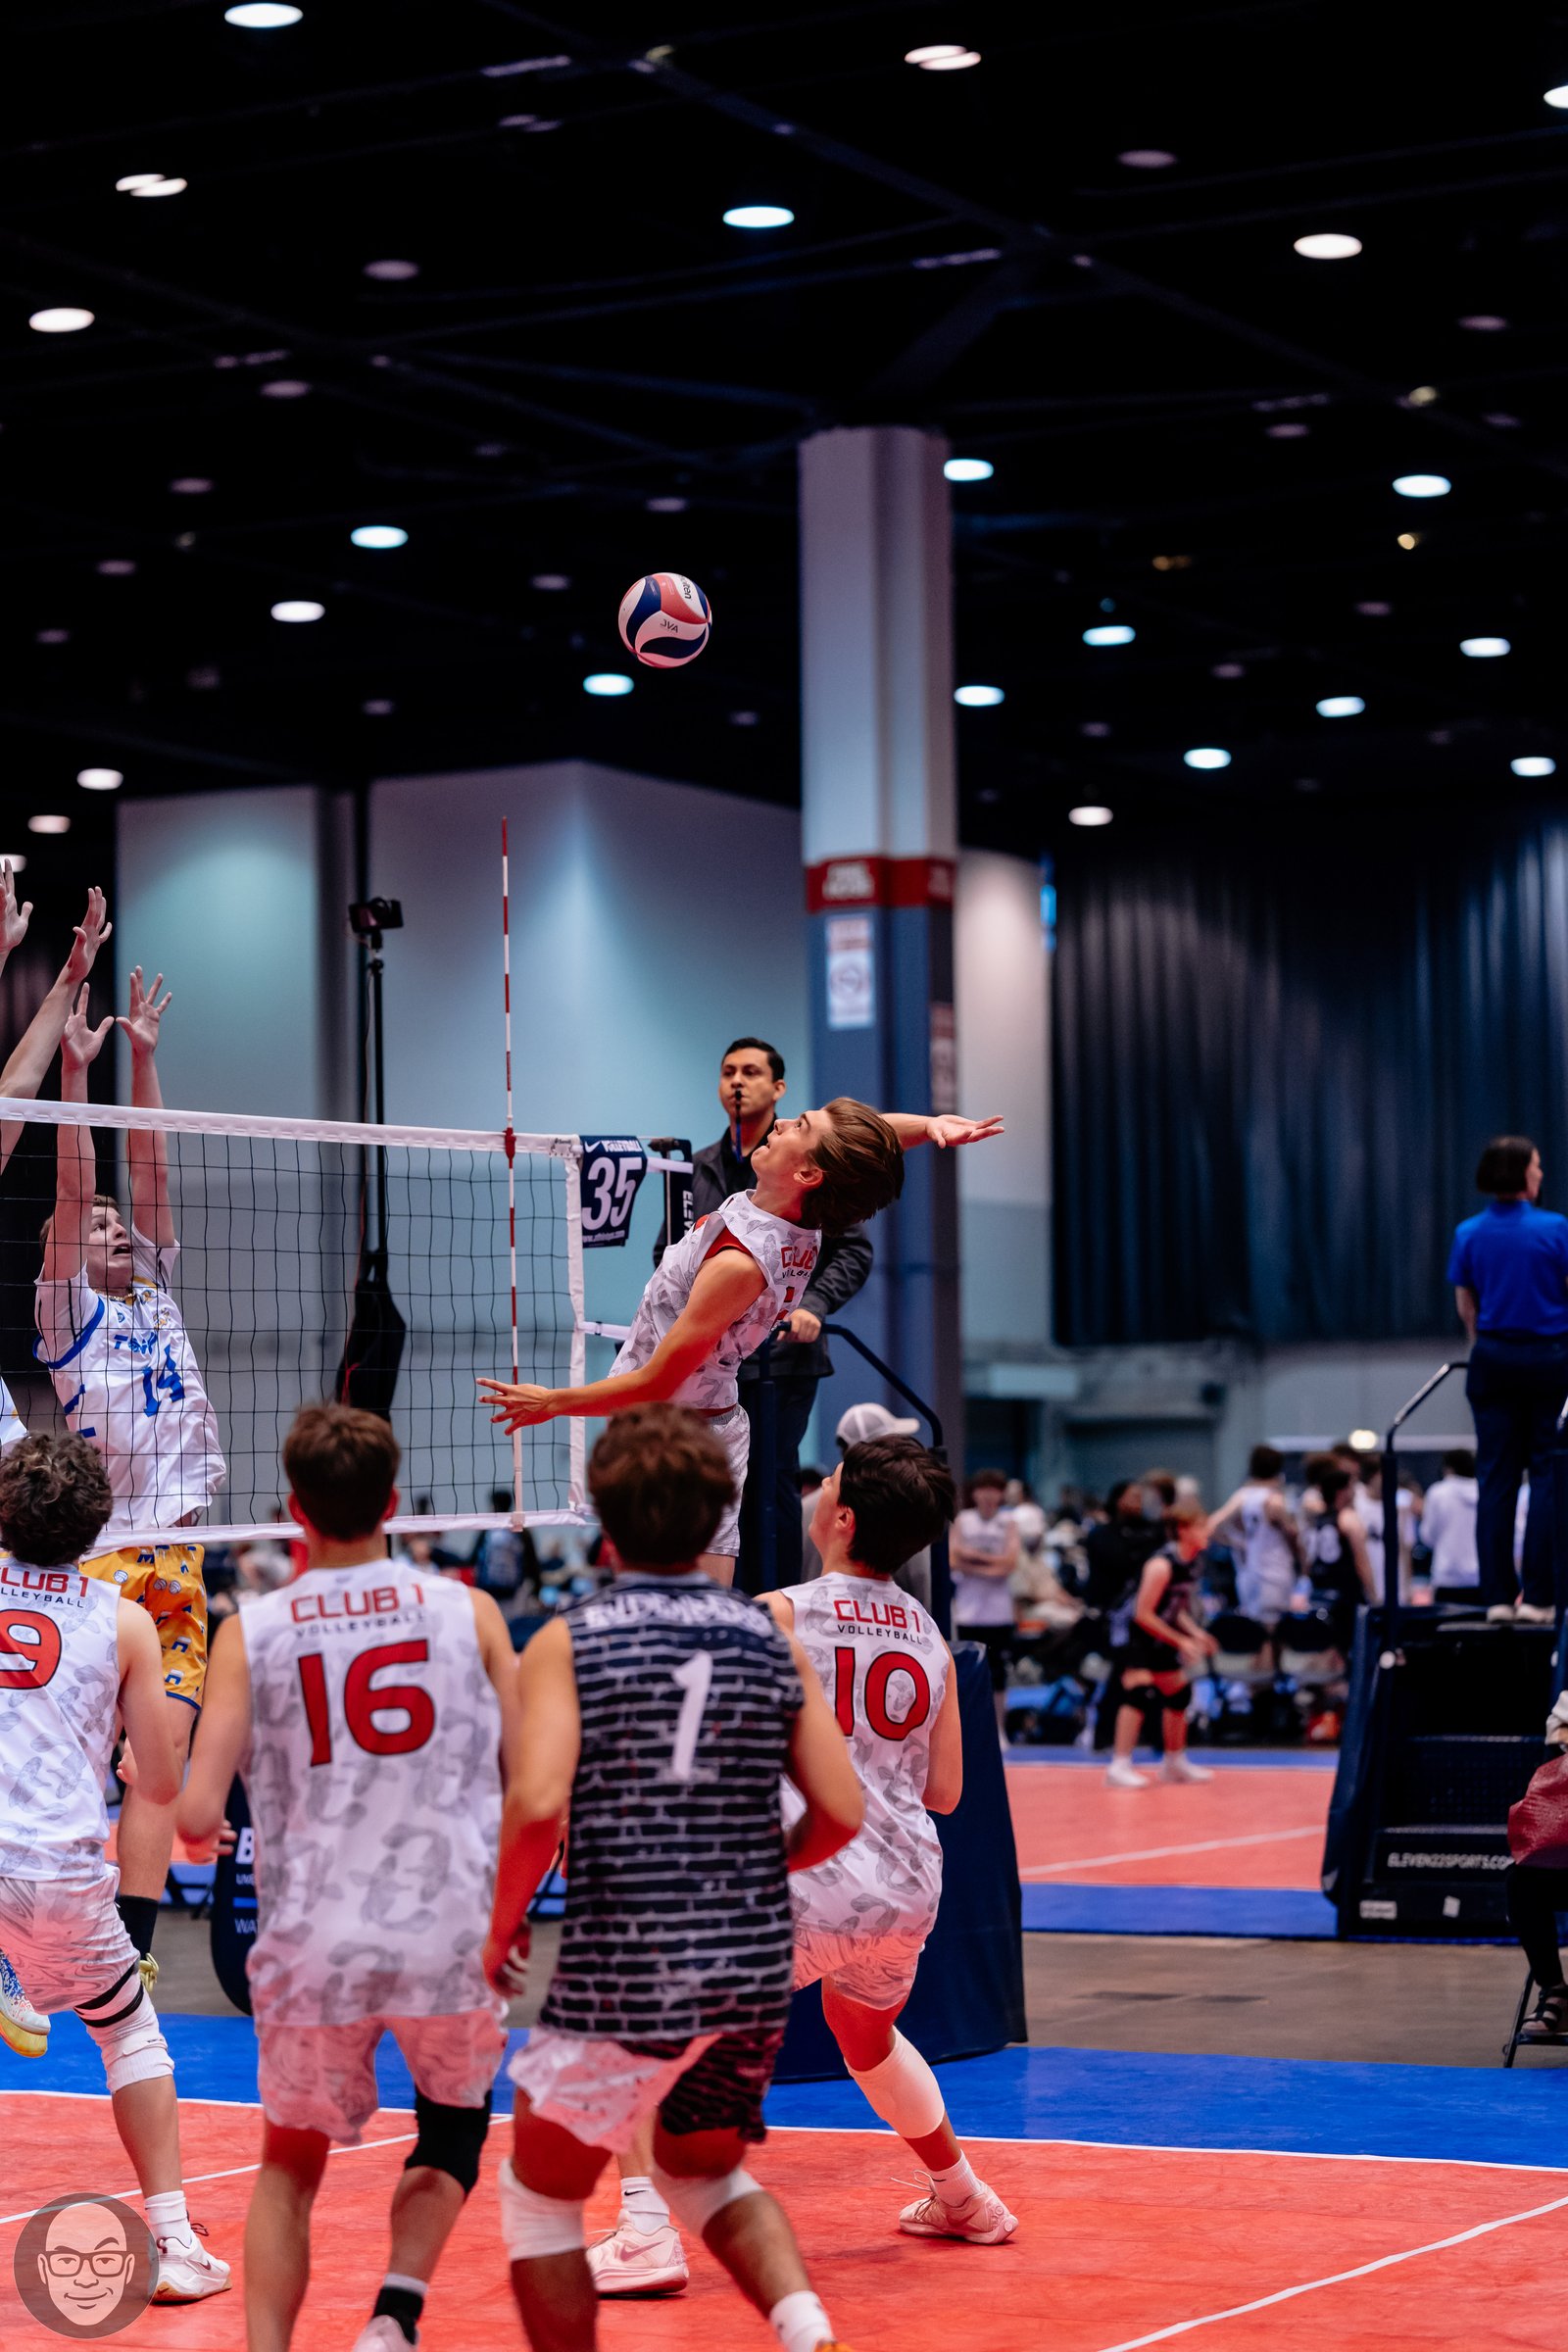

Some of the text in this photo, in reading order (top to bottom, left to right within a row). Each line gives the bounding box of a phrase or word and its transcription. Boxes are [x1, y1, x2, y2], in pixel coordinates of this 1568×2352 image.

[660, 618, 679, 633] JVA
[581, 1156, 643, 1231] 35
[141, 1344, 186, 1418] 14
[0, 1567, 89, 1597] LUB 1
[290, 1583, 424, 1624] CLUB 1
[834, 1599, 921, 1634] CLUB 1
[295, 1612, 425, 1639] VOLLEYBALL
[837, 1624, 923, 1645] VOLLEYBALL
[297, 1639, 436, 1767] 16
[834, 1645, 932, 1741] 10
[669, 1650, 714, 1782] 1
